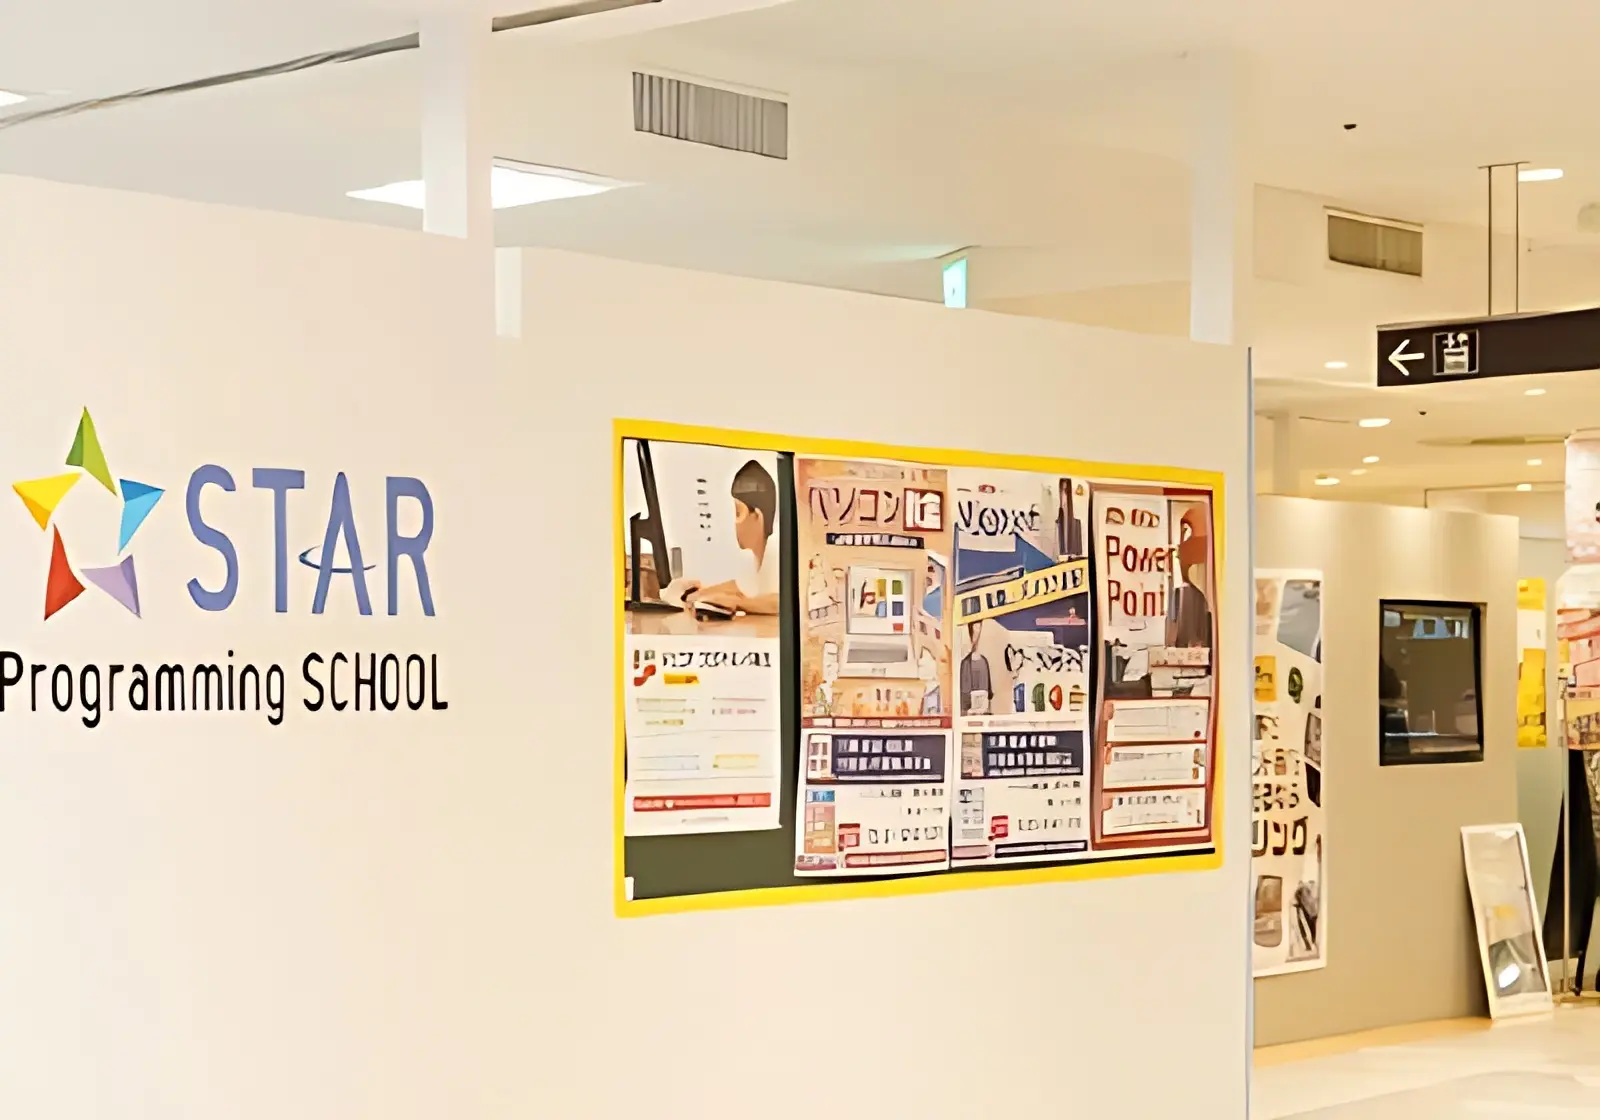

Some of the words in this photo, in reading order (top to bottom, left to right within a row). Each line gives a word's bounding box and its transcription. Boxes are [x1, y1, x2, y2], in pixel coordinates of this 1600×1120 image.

[186, 464, 436, 617] STAR
[0, 650, 285, 728] Programming
[302, 652, 448, 712] SCHOOL
